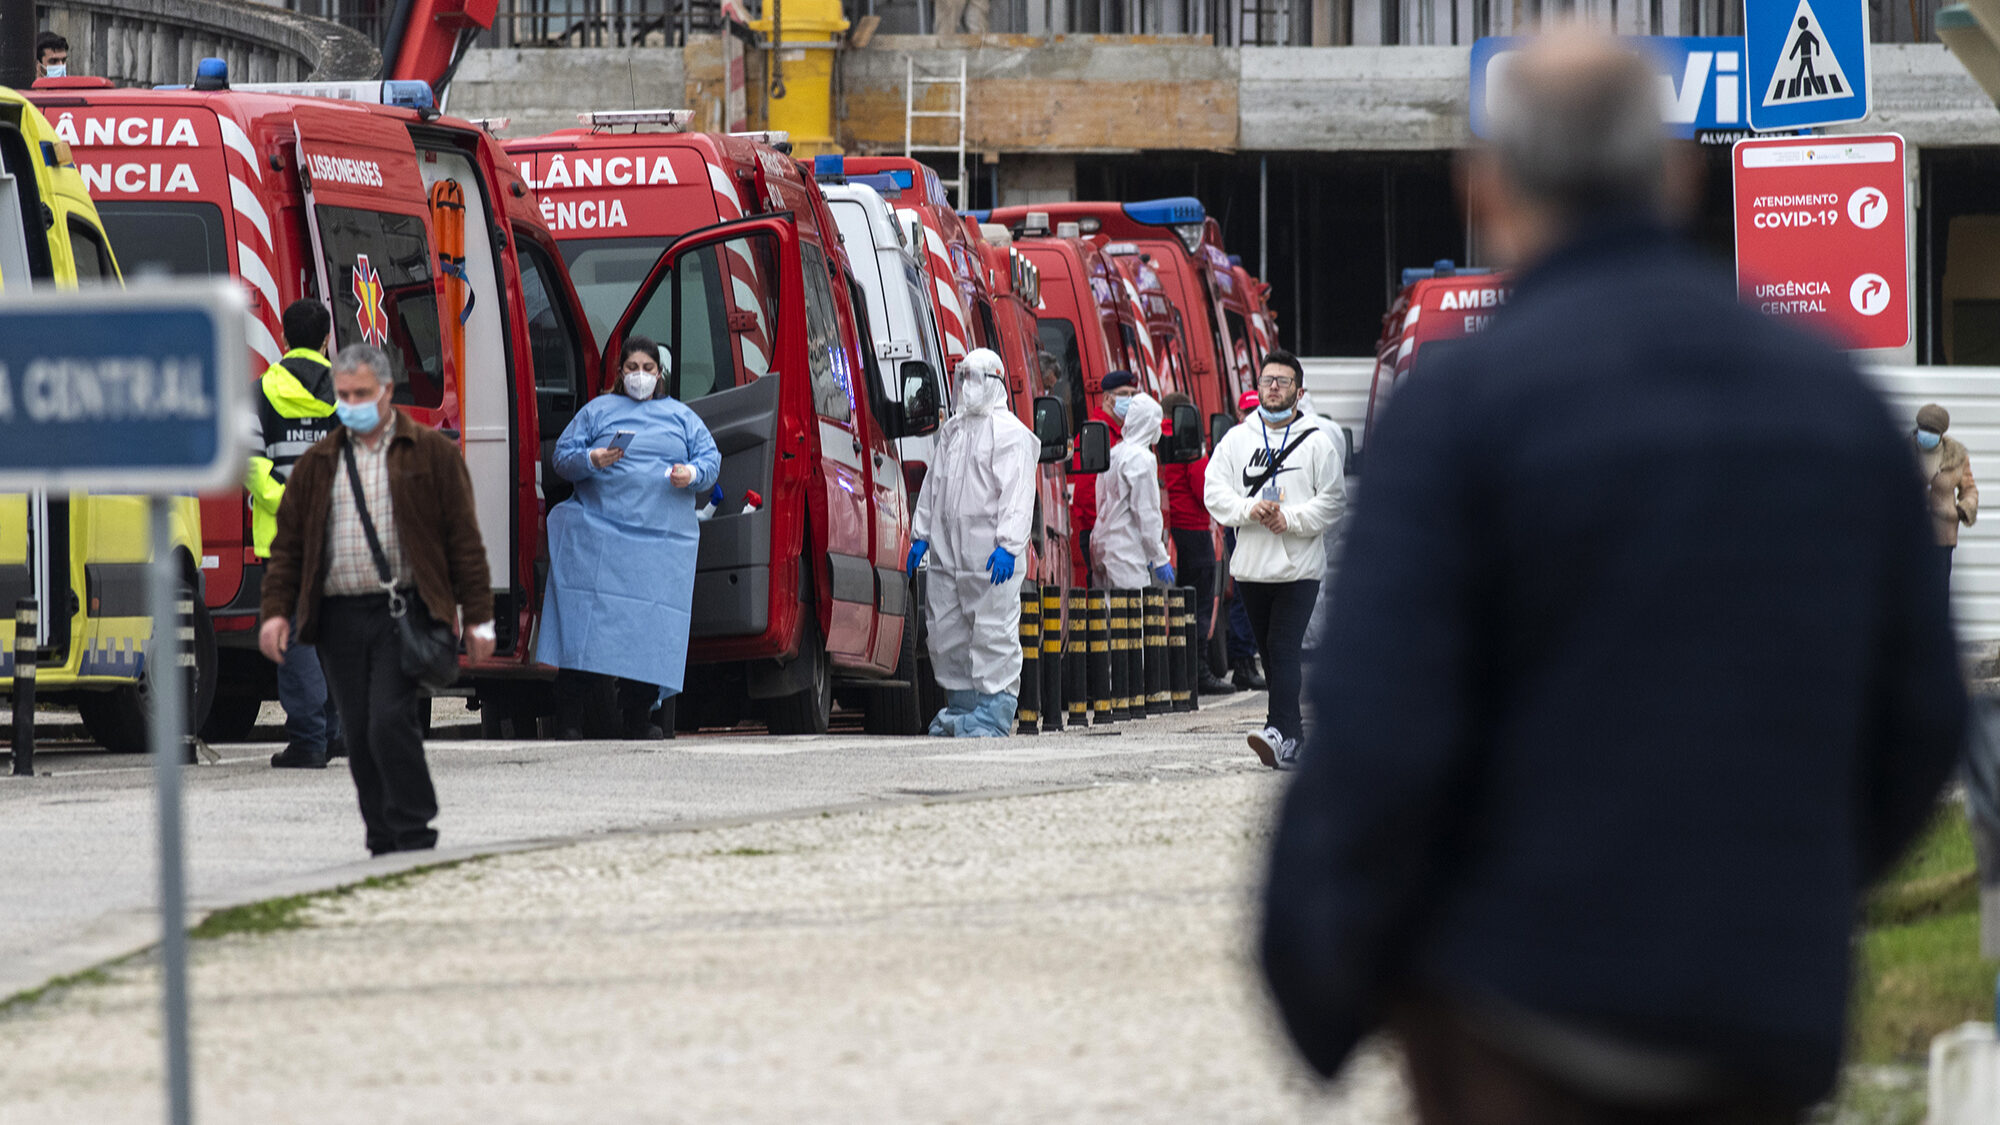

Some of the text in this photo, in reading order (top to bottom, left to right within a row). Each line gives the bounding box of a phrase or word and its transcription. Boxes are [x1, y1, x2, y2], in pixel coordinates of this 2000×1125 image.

[306, 153, 383, 188] LISBONENSES
[518, 154, 679, 190] LÂNCIA
[1753, 193, 1839, 208] ATENDIMENTO
[1753, 210, 1839, 229] COVID-19
[1755, 280, 1831, 298] URGÊNCIA
[1761, 299, 1827, 315] CENTRAL
[286, 429, 328, 442] INEM
[1248, 448, 1284, 469] NIK
